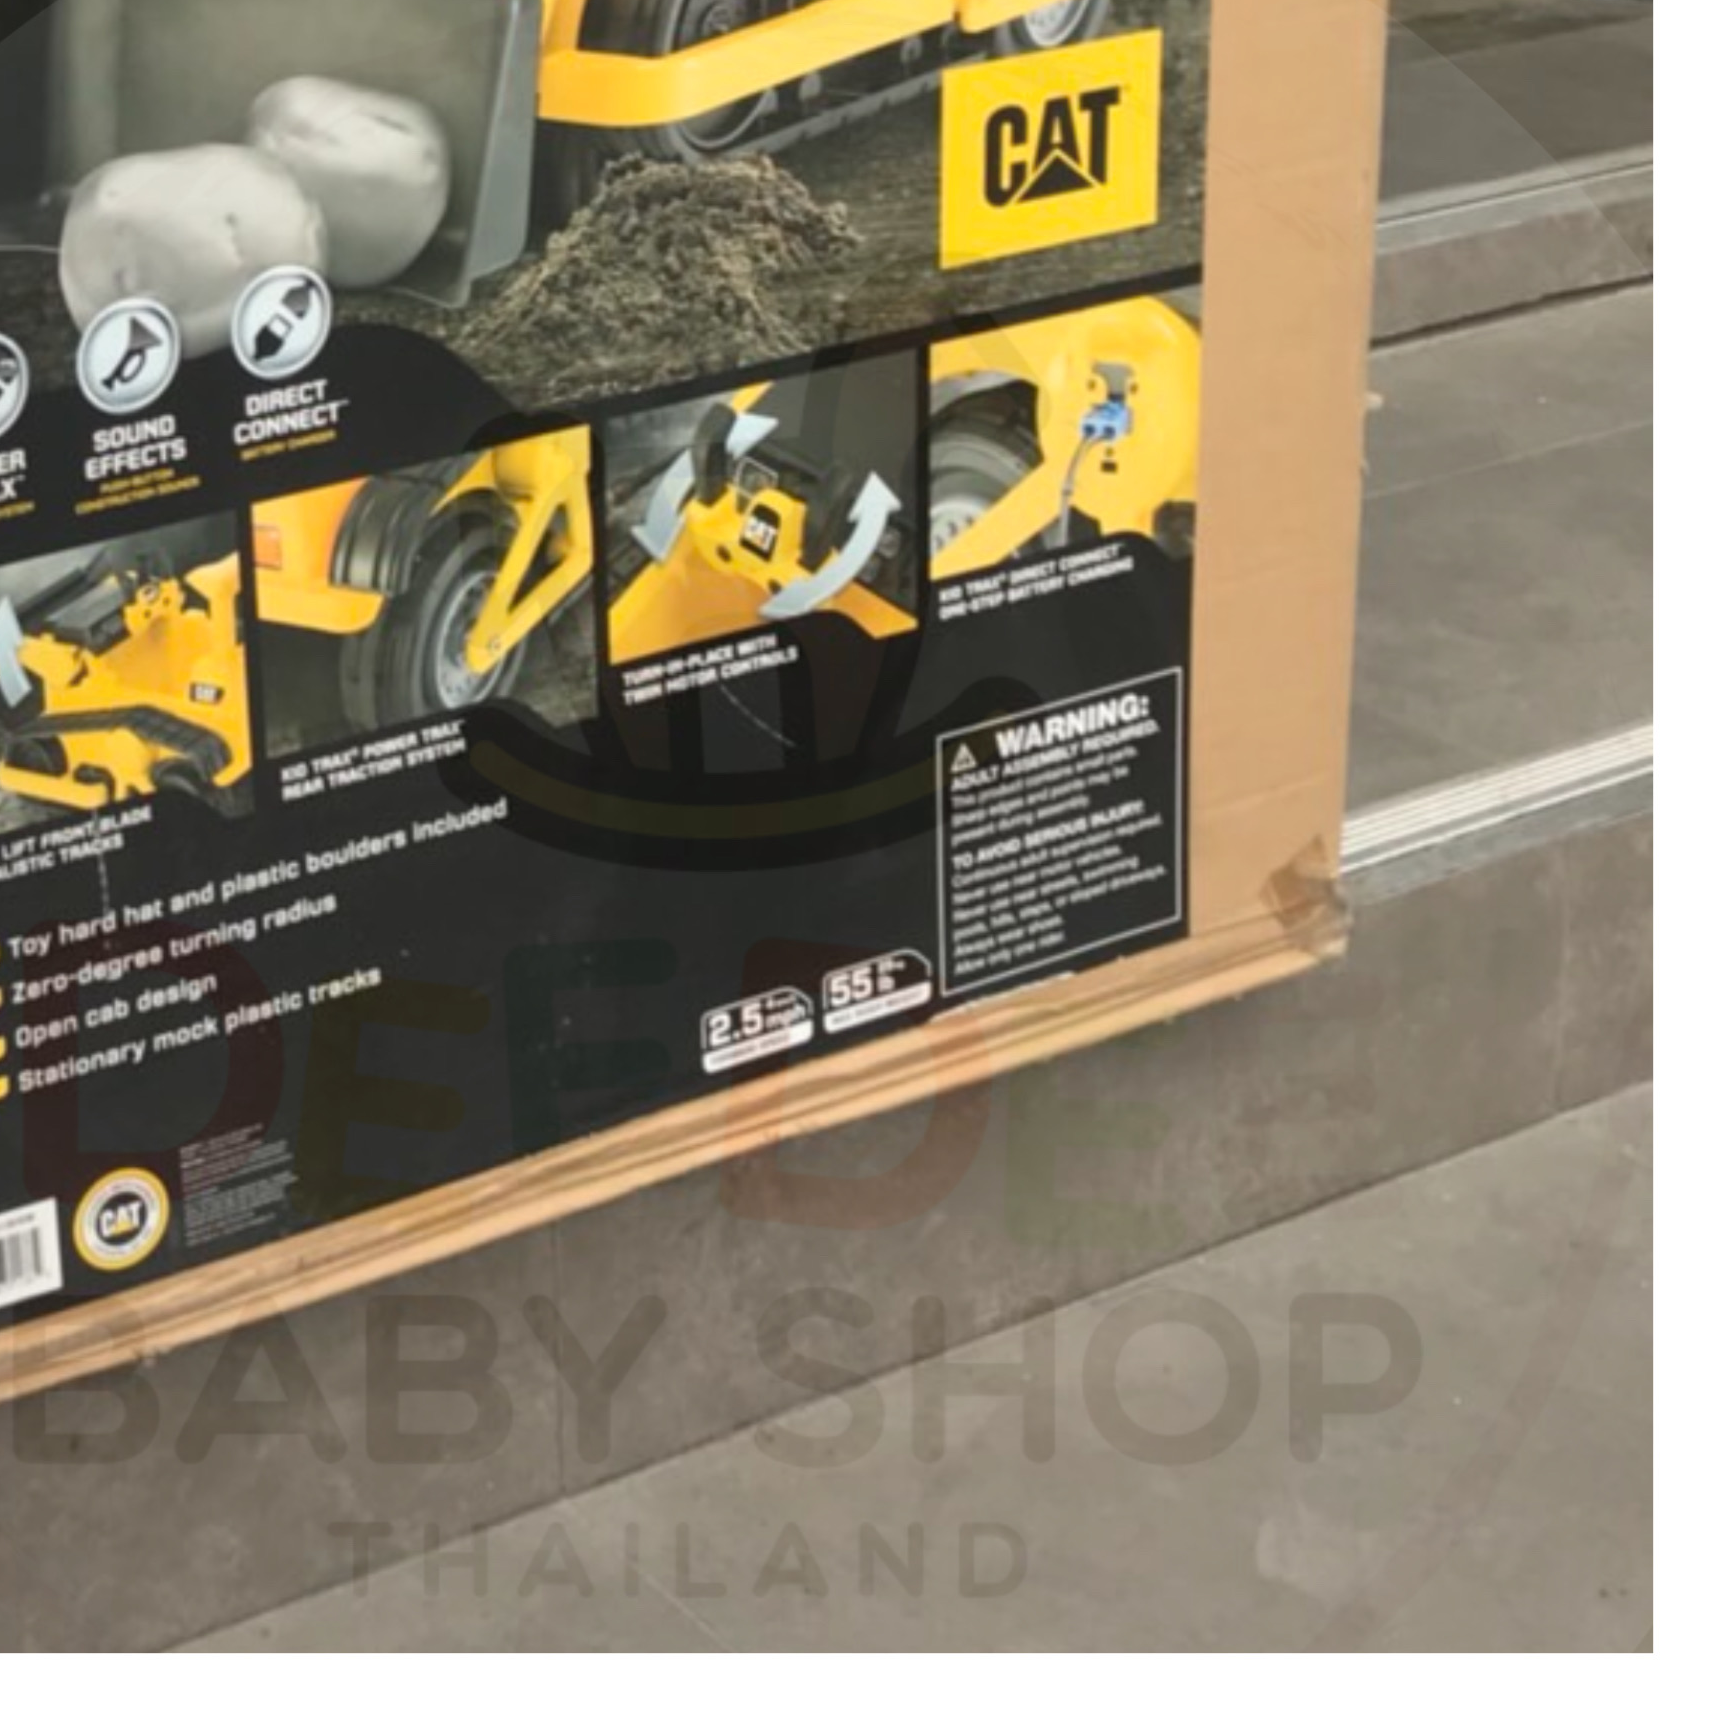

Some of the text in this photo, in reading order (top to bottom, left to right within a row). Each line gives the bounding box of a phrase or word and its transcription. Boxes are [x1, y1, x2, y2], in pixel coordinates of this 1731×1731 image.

[984, 84, 1122, 208] CAT
[244, 378, 328, 417] DIRECT
[93, 415, 176, 453] SOUND
[233, 402, 341, 446] CONNECT
[84, 437, 188, 481] EFFECTS
[1006, 574, 1065, 603] BATTERY
[1009, 560, 1057, 586] DIRECT
[736, 632, 777, 657] WITH
[664, 666, 718, 692] MOTOR
[720, 644, 799, 680] CONTROLS
[362, 730, 418, 760] POWER
[994, 692, 1150, 758] WARNING:
[281, 737, 466, 802] REAR TRACTION SYSTEM
[950, 764, 1001, 793] ADULT
[1001, 741, 1080, 778] ASSEMBLY
[0, 836, 37, 861] LIFT
[39, 822, 94, 850] FRONT
[97, 804, 153, 834] BLADE
[57, 831, 124, 865] TRACKS
[951, 851, 974, 870] TO
[976, 837, 1022, 864] AVOID
[1023, 816, 1089, 850] SERIOUS
[7, 795, 509, 961] Toy hard hat and plastic boulders included
[11, 893, 338, 1005] Zero-degree turning radius
[830, 967, 873, 1006] 55
[15, 973, 218, 1049] Open cab design
[18, 965, 383, 1094] Stationary mock plastic tracks
[708, 1002, 765, 1047] 2.5
[99, 1199, 144, 1238] CAT
